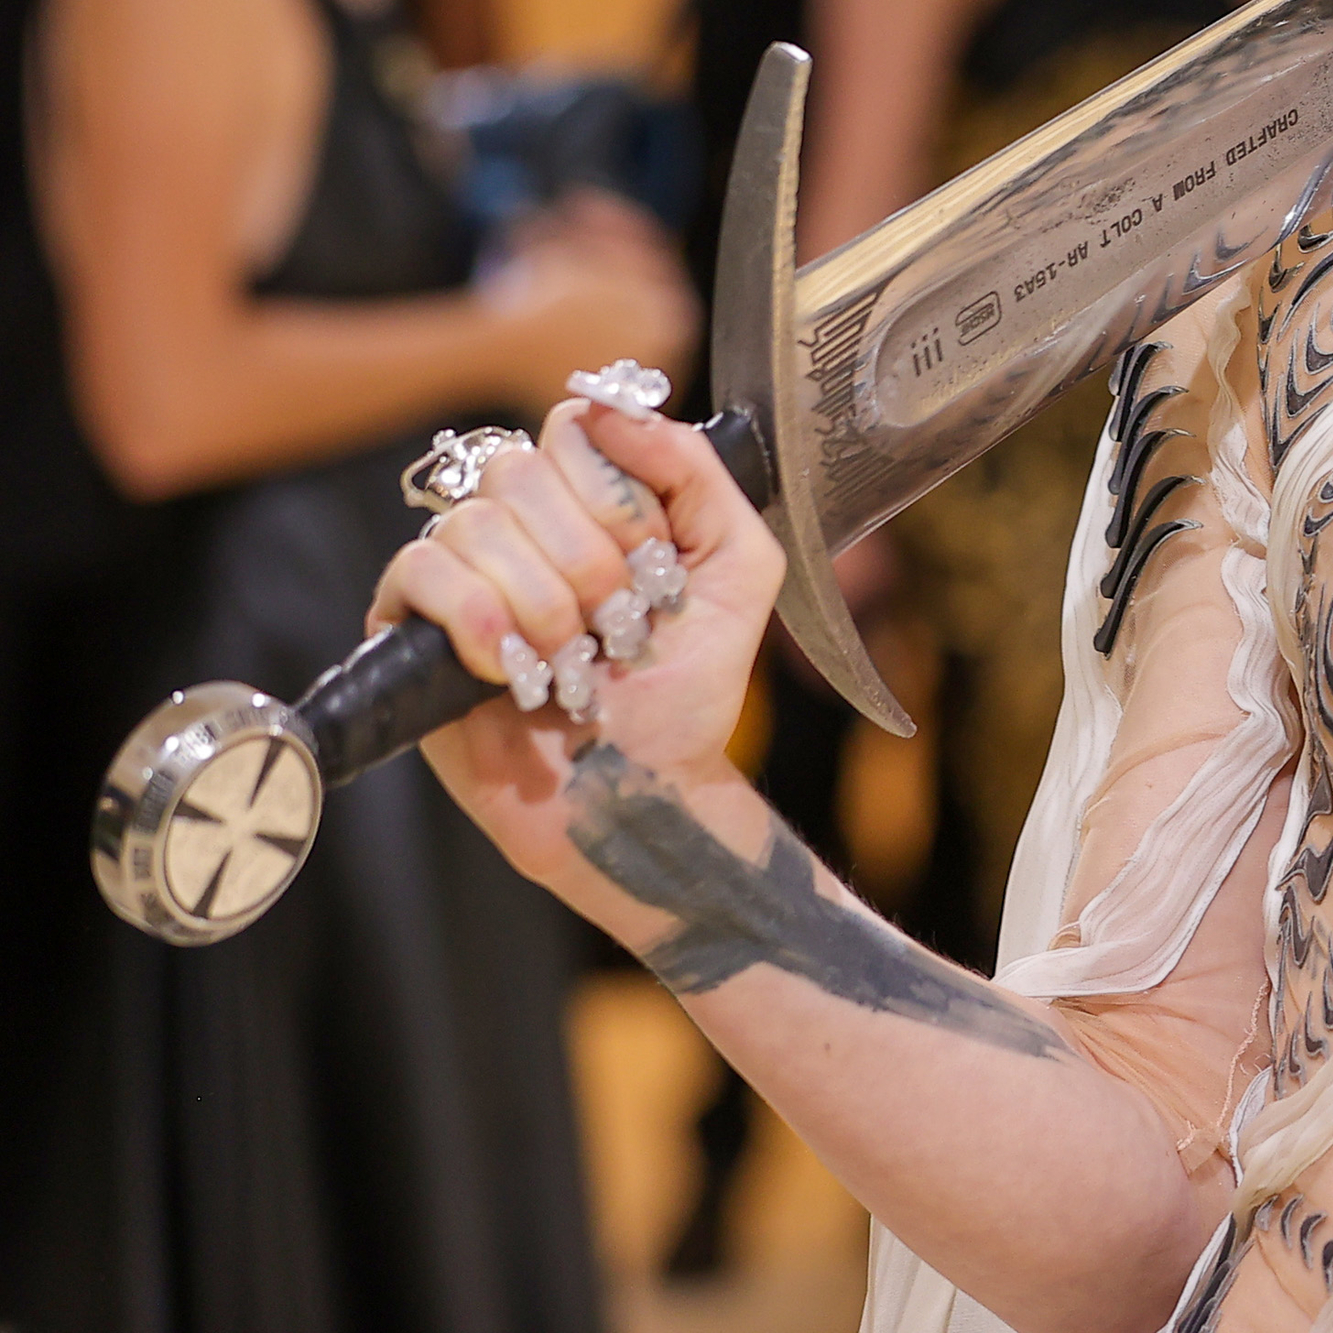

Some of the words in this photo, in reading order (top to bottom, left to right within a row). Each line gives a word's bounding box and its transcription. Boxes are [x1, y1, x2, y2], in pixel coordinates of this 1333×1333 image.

[1225, 108, 1300, 167] CRAFTED
[1173, 165, 1217, 201] FROM
[1150, 197, 1164, 213] A
[1100, 208, 1143, 249] COLT
[1013, 240, 1089, 303] AR-15A3
